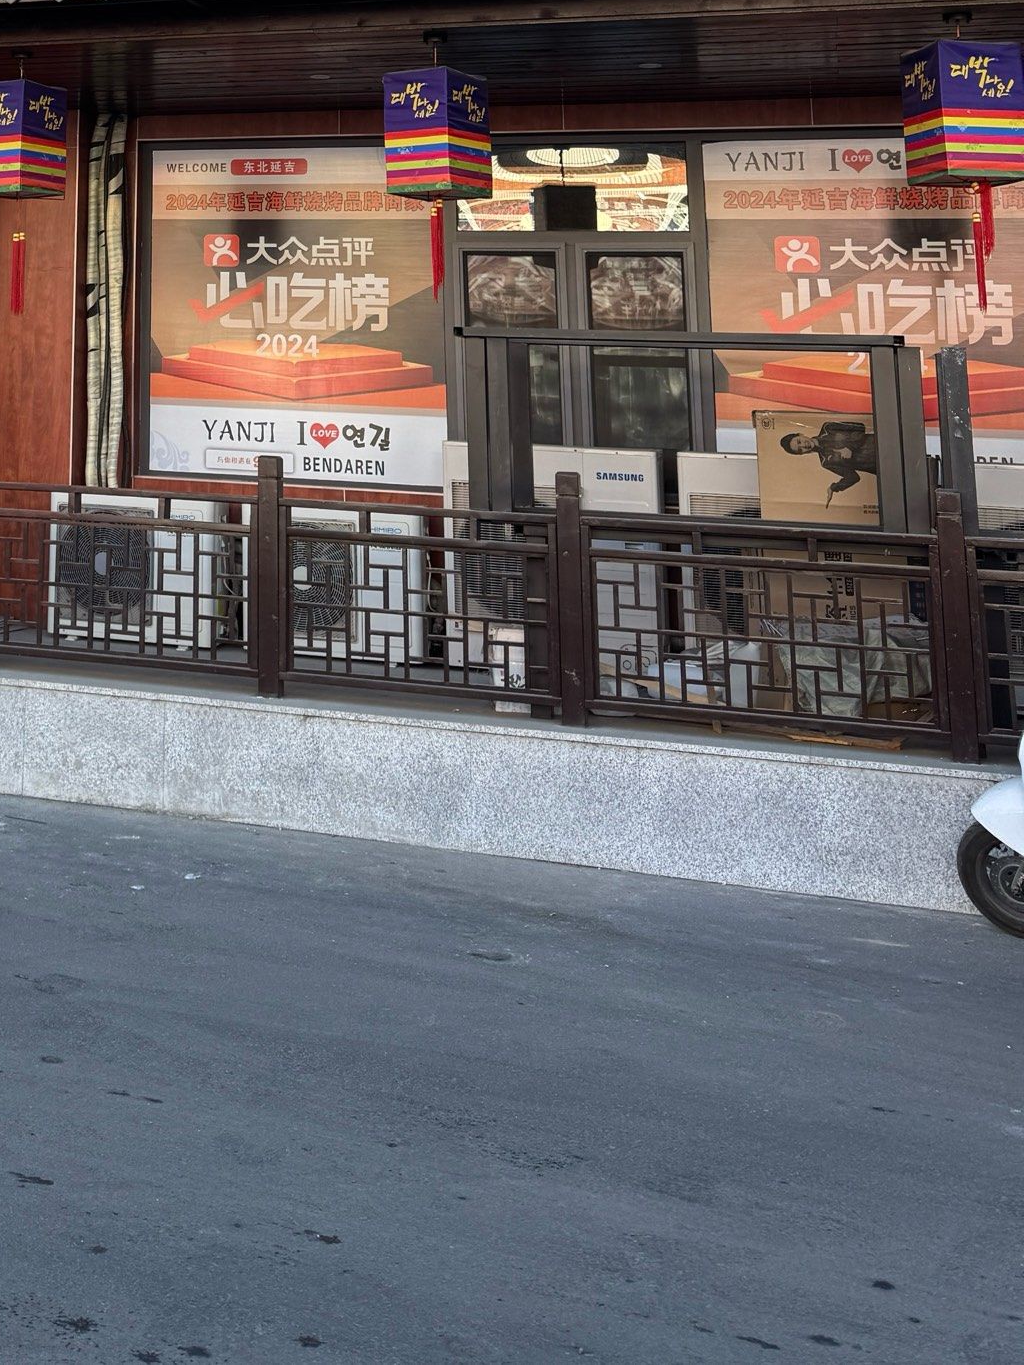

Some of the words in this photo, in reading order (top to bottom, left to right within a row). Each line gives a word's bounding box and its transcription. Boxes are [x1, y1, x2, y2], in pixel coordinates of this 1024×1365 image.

[166, 163, 227, 174] WELCOME
[243, 161, 296, 174] 东北延吉
[725, 150, 805, 173] YANJI
[843, 155, 872, 163] LOVE
[246, 236, 375, 267] 大众点评
[202, 271, 390, 332] 必吃榜
[778, 278, 1014, 345] 必吃榜
[255, 333, 320, 359] 2024
[202, 419, 276, 444] YANJI
[311, 428, 338, 439] LOVE
[341, 423, 391, 451] 연길
[303, 456, 386, 477] BENDAREN
[595, 470, 645, 483] SAMSUNG
